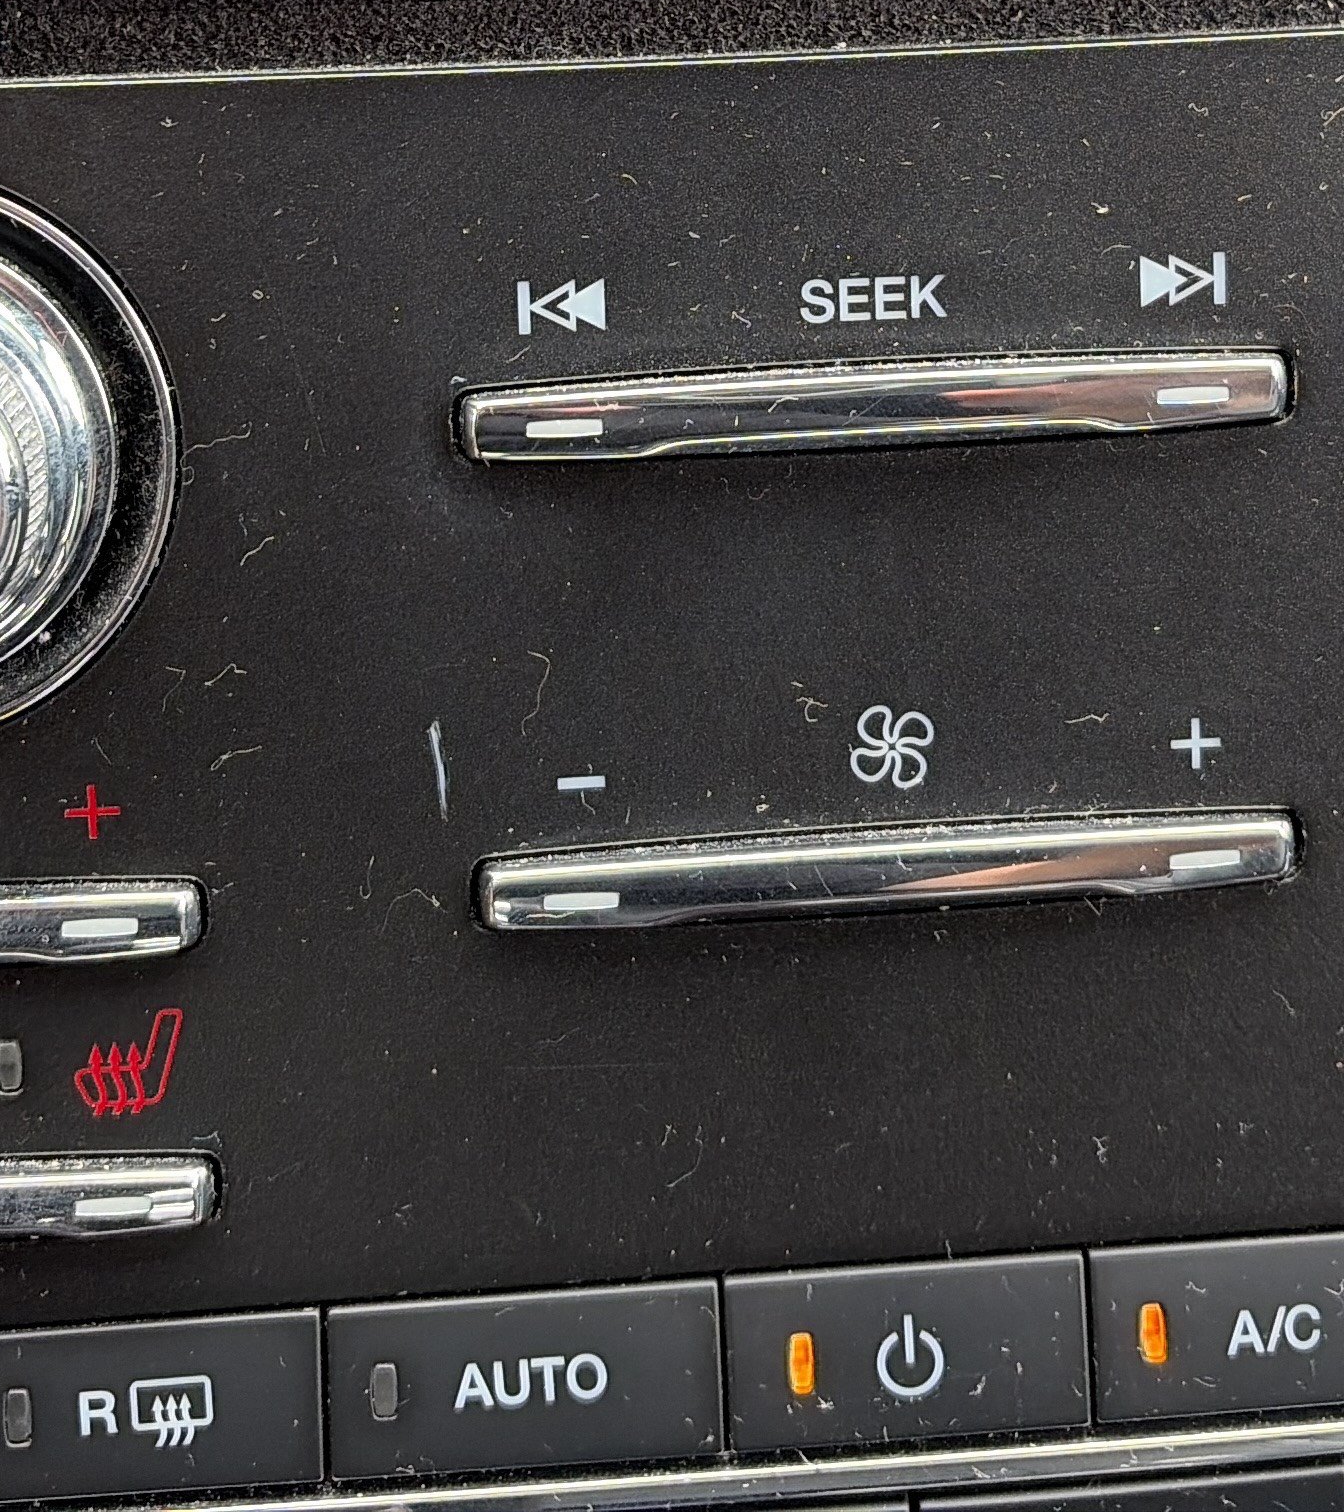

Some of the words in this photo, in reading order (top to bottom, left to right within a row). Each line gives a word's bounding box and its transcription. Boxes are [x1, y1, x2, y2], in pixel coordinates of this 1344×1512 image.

[799, 273, 948, 325] SEEK
[1226, 1302, 1322, 1357] A/C
[453, 1352, 609, 1410] AUTO
[77, 1389, 119, 1437] R
